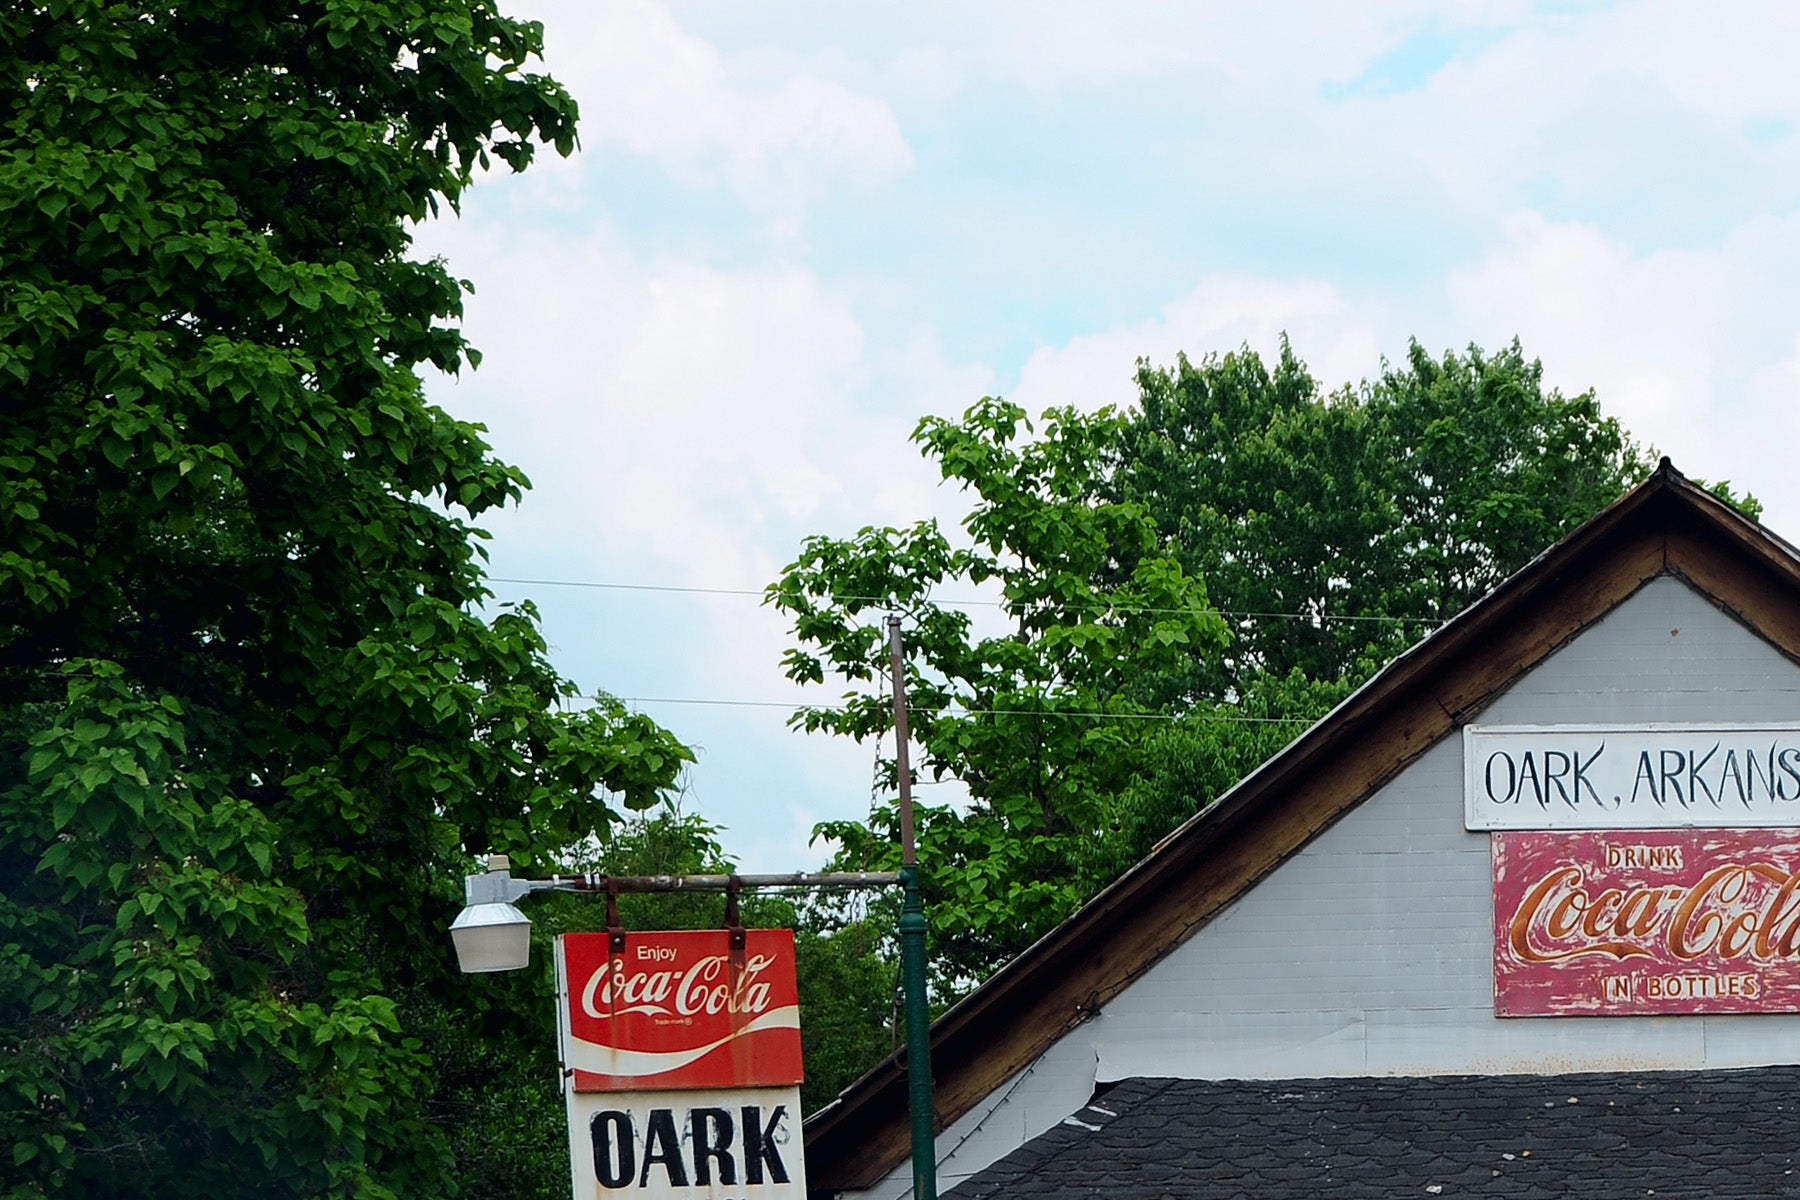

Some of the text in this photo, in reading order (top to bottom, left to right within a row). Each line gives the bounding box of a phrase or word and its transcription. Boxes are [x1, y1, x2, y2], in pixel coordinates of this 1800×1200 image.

[1608, 848, 1682, 867] DRINK
[637, 945, 677, 961] Enjoy
[582, 953, 777, 1019] Coca-Cola
[1602, 976, 1757, 997] IN BOTTLES
[591, 1105, 791, 1189] OARK
